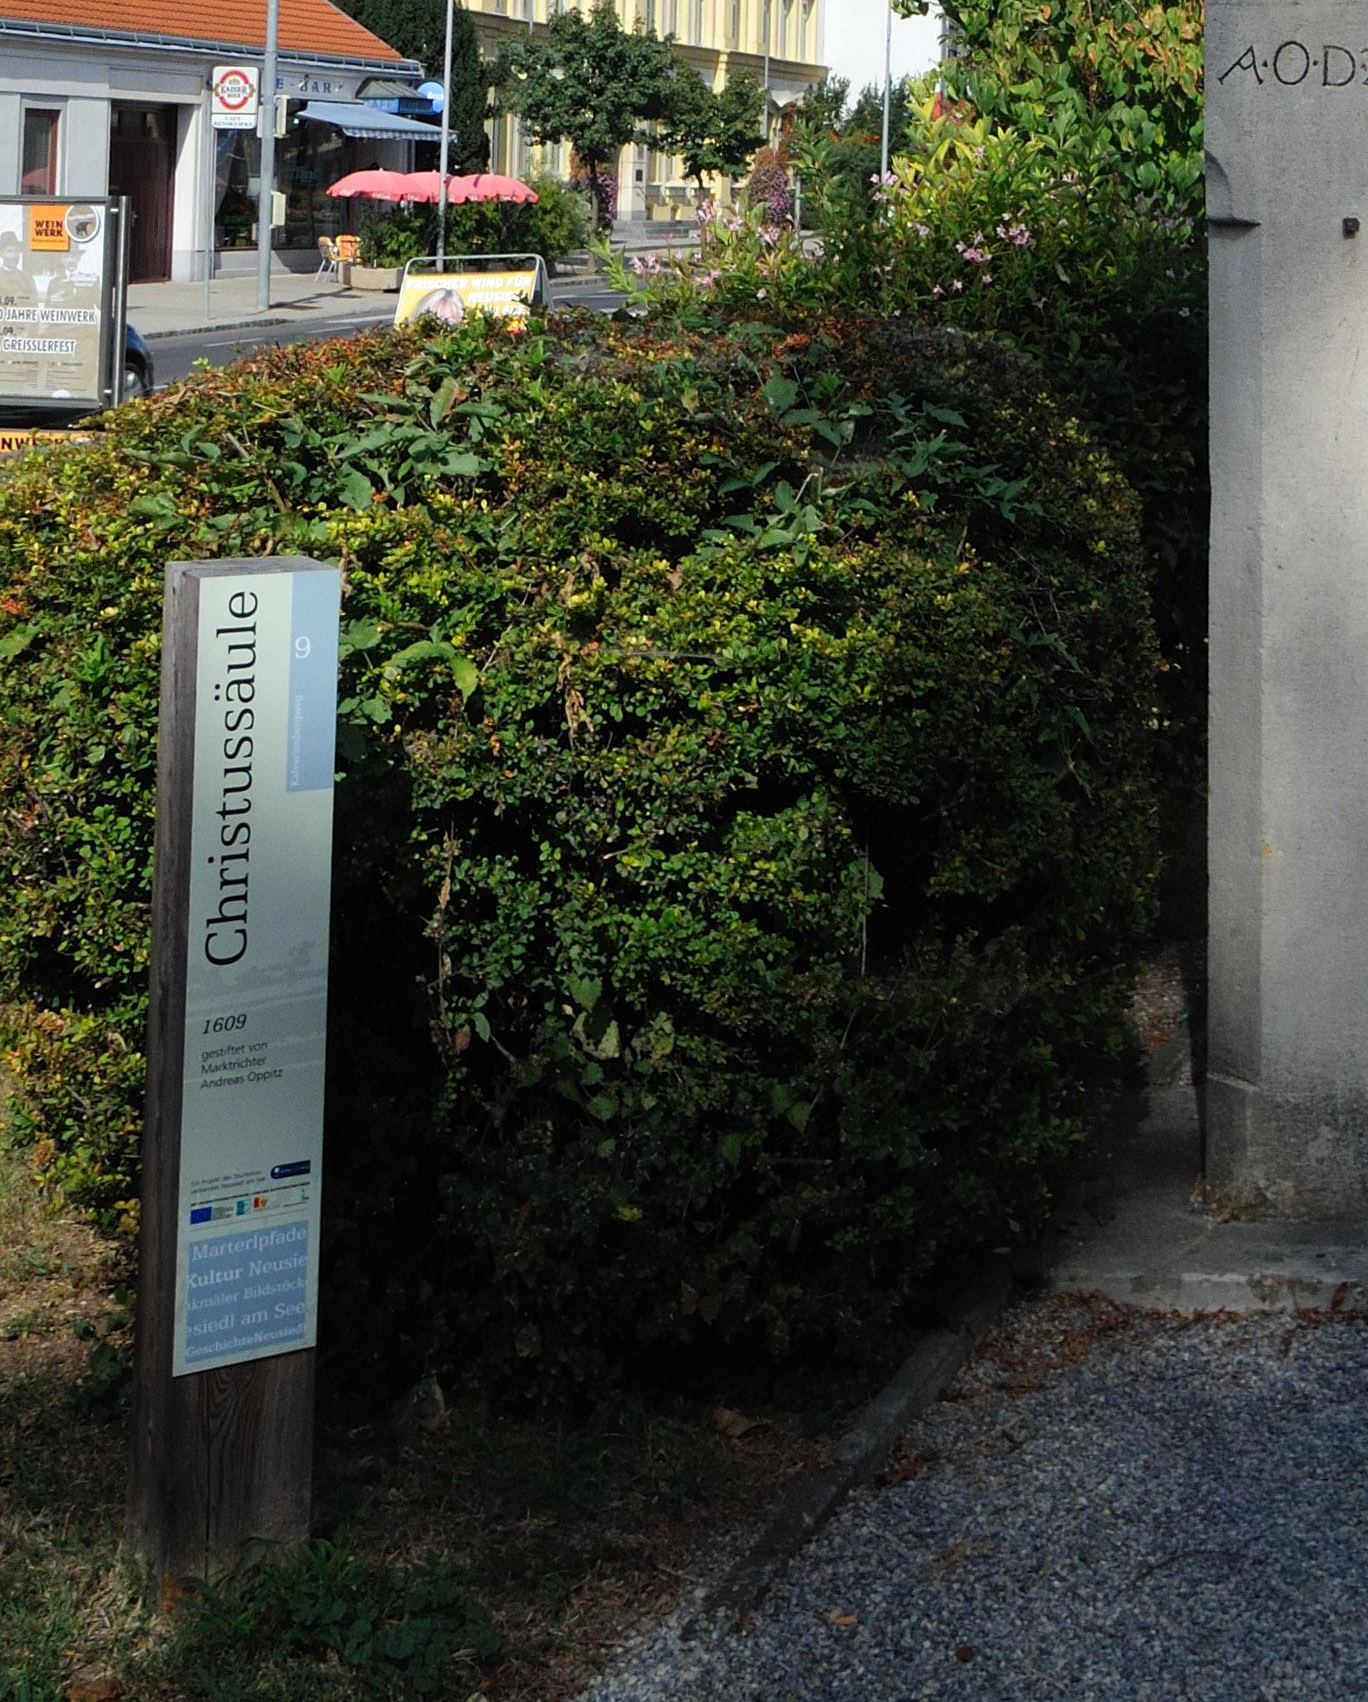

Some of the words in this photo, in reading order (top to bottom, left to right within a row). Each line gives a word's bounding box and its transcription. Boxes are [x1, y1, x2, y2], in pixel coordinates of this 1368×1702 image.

[35, 219, 63, 229] WEIN
[35, 228, 63, 237] WERK
[6, 309, 37, 321] JAHRE
[40, 309, 96, 323] WEINWERK
[3, 339, 76, 353] GREISSLERFEST
[295, 635, 311, 659] 9
[204, 589, 260, 966] Christussäule
[202, 1013, 248, 1035] 1609
[201, 1044, 246, 1063] gestiftet
[248, 1041, 268, 1053] von
[201, 1057, 267, 1075] Marktrichter
[200, 1075, 245, 1090] Andreas
[247, 1067, 283, 1083] Oppitz
[192, 1226, 307, 1261] Marterlpfade
[188, 1266, 243, 1288] Kultur
[240, 1309, 268, 1326] am
[273, 1300, 306, 1319] See
